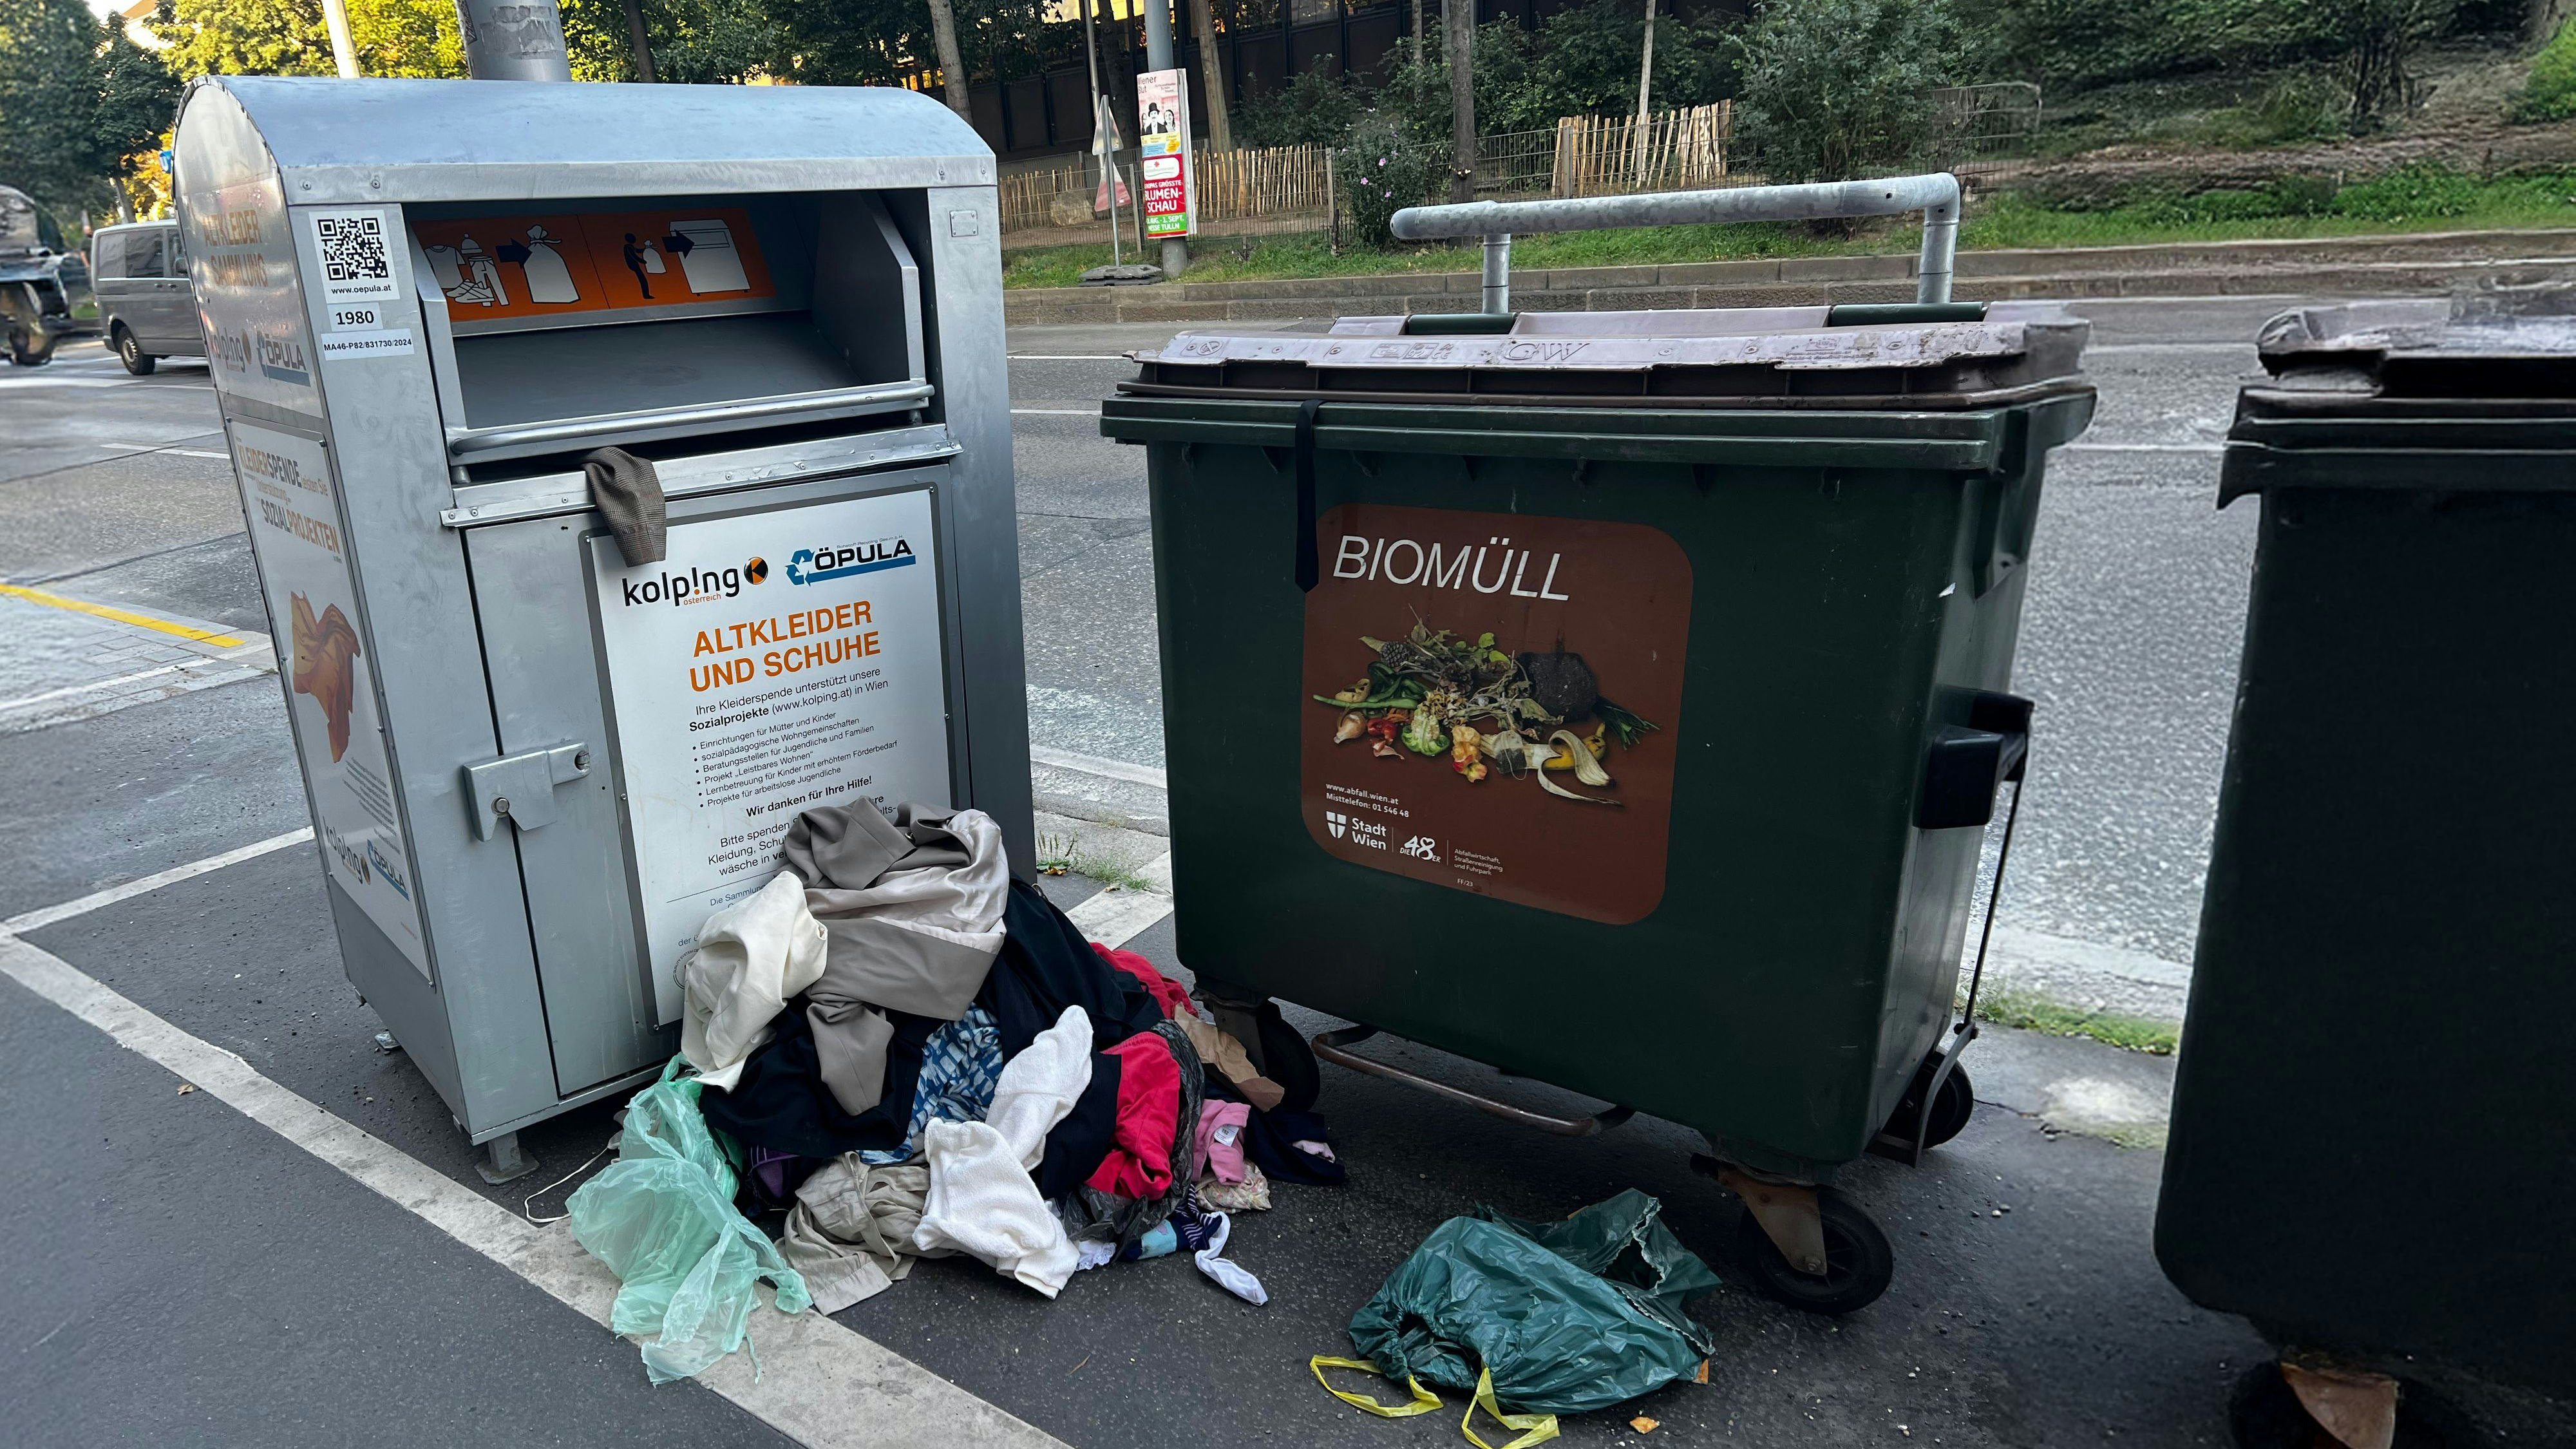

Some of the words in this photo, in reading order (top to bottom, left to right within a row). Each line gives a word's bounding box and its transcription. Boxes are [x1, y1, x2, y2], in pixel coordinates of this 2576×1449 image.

[1147, 200, 1177, 213] SCHAU
[331, 284, 392, 294] www.oepula.at
[336, 310, 374, 325] 1980
[265, 333, 307, 371] ÖPULA
[324, 339, 412, 351] MA46-P82/831730/2024
[1503, 342, 1589, 361] GW
[237, 444, 302, 488] KLEIDERSPENDE
[261, 498, 341, 554] SOZIALPROJEKTEN
[814, 539, 913, 571] ÖPULA
[1332, 536, 1569, 601] BIOMÜLL
[683, 592, 721, 606] österreich
[694, 600, 872, 658] ALTKLEIDER
[689, 658, 754, 692] UND
[764, 630, 881, 677] SCHUHE
[696, 704, 716, 715] Ihre
[719, 687, 793, 710] Kleiderspende
[795, 675, 848, 693] unterstützt
[849, 668, 880, 681] unsere
[689, 706, 770, 732] Sozialprojekte
[772, 689, 853, 715] (www.kolping.at)
[855, 685, 863, 695] in
[865, 679, 889, 692] Wien
[700, 731, 755, 750] Einrichtungen
[756, 727, 767, 736] für
[769, 721, 794, 733] Mütter
[796, 719, 811, 728] und
[812, 711, 837, 723] Kinder
[701, 735, 780, 761] sozialpädagogische
[781, 717, 860, 743] Wohngemeinschaften
[703, 751, 769, 773] Beratungsstellen
[770, 747, 781, 757] für
[782, 735, 828, 755] Jugendliche
[829, 733, 844, 743] und
[845, 724, 875, 739] Familien
[705, 771, 733, 786] Projekt
[735, 759, 779, 778] „Leistbares
[706, 776, 764, 797] Lernbetreuung
[764, 772, 776, 781] für
[777, 764, 802, 777] Kinder
[804, 761, 816, 770] mit
[817, 752, 852, 768] erhöhtem
[708, 793, 741, 809] Projekte
[742, 788, 752, 798] für
[754, 779, 796, 795] arbeitslose
[797, 766, 842, 784] Jugendliche
[746, 806, 765, 817] Wir
[768, 795, 806, 812] danken
[808, 789, 823, 801] für
[825, 783, 845, 796] Ihre
[847, 775, 873, 791] Hilfe!
[1326, 783, 1399, 805] www.abfall.wien.at
[1326, 792, 1371, 809] Misttelefon:
[1372, 803, 1381, 811] 01
[1383, 806, 1398, 815] 546
[1399, 810, 1409, 818] 48
[720, 835, 744, 848] Bitte
[747, 822, 790, 841] spenden
[1352, 818, 1387, 837] Stadt
[1352, 831, 1387, 850] Wien
[708, 846, 756, 866] Kleidung,
[719, 859, 759, 876] wäsche
[761, 855, 770, 864] in
[1454, 848, 1501, 864] Abfallwirtschaft,
[1454, 855, 1503, 872] Straßenreinigung
[374, 847, 406, 892] ÖPULA
[1457, 878, 1473, 887] FF/23
[1466, 865, 1492, 875] Fuhrpark
[710, 898, 723, 906] Die
[678, 937, 692, 947] der
